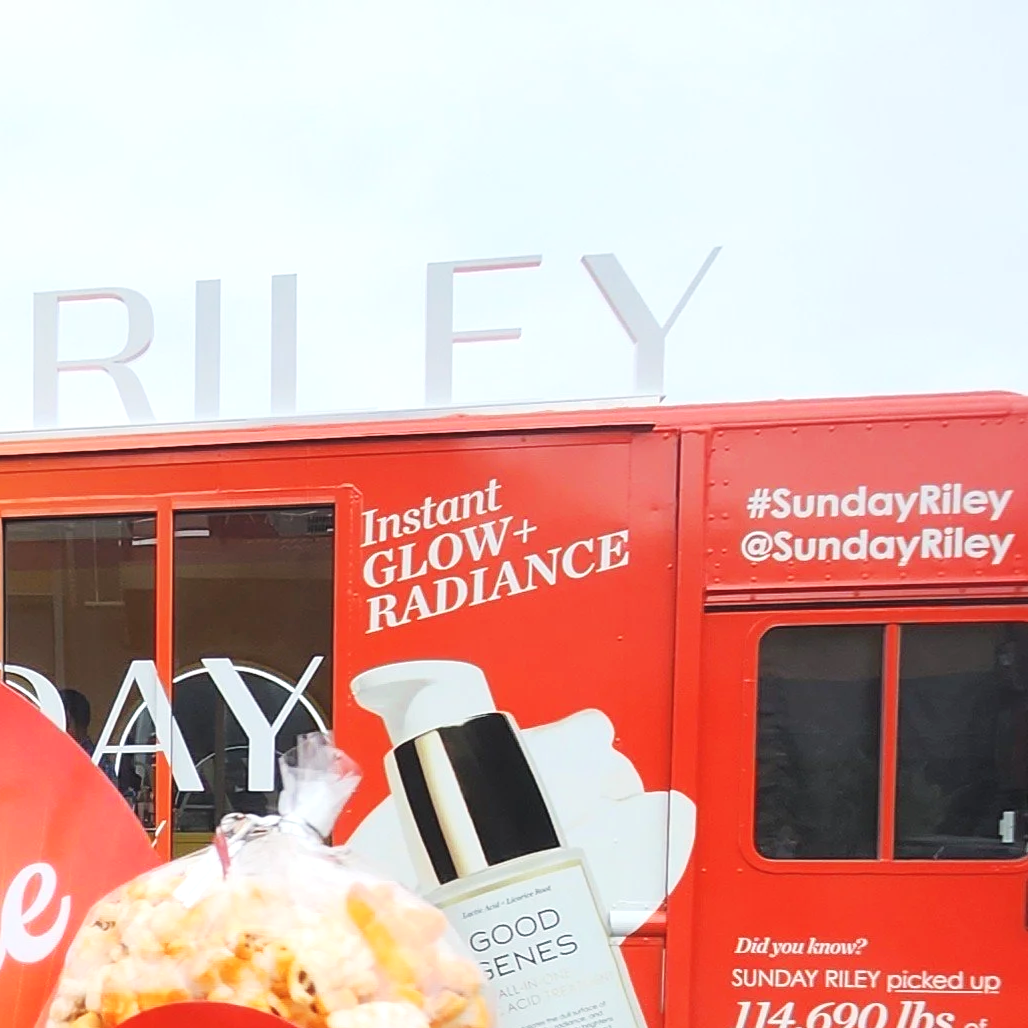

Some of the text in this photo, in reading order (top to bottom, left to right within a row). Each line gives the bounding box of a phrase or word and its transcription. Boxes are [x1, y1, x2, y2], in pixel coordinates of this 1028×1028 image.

[360, 478, 502, 548] Instant
[746, 483, 1014, 523] #SundayRiley
[740, 527, 1015, 567] @SundayRiley
[364, 529, 630, 635] RADIANCE
[469, 908, 560, 953] GOOD
[734, 937, 868, 958] Did you know?
[731, 969, 1001, 994] SUNDAY RILEY picked up
